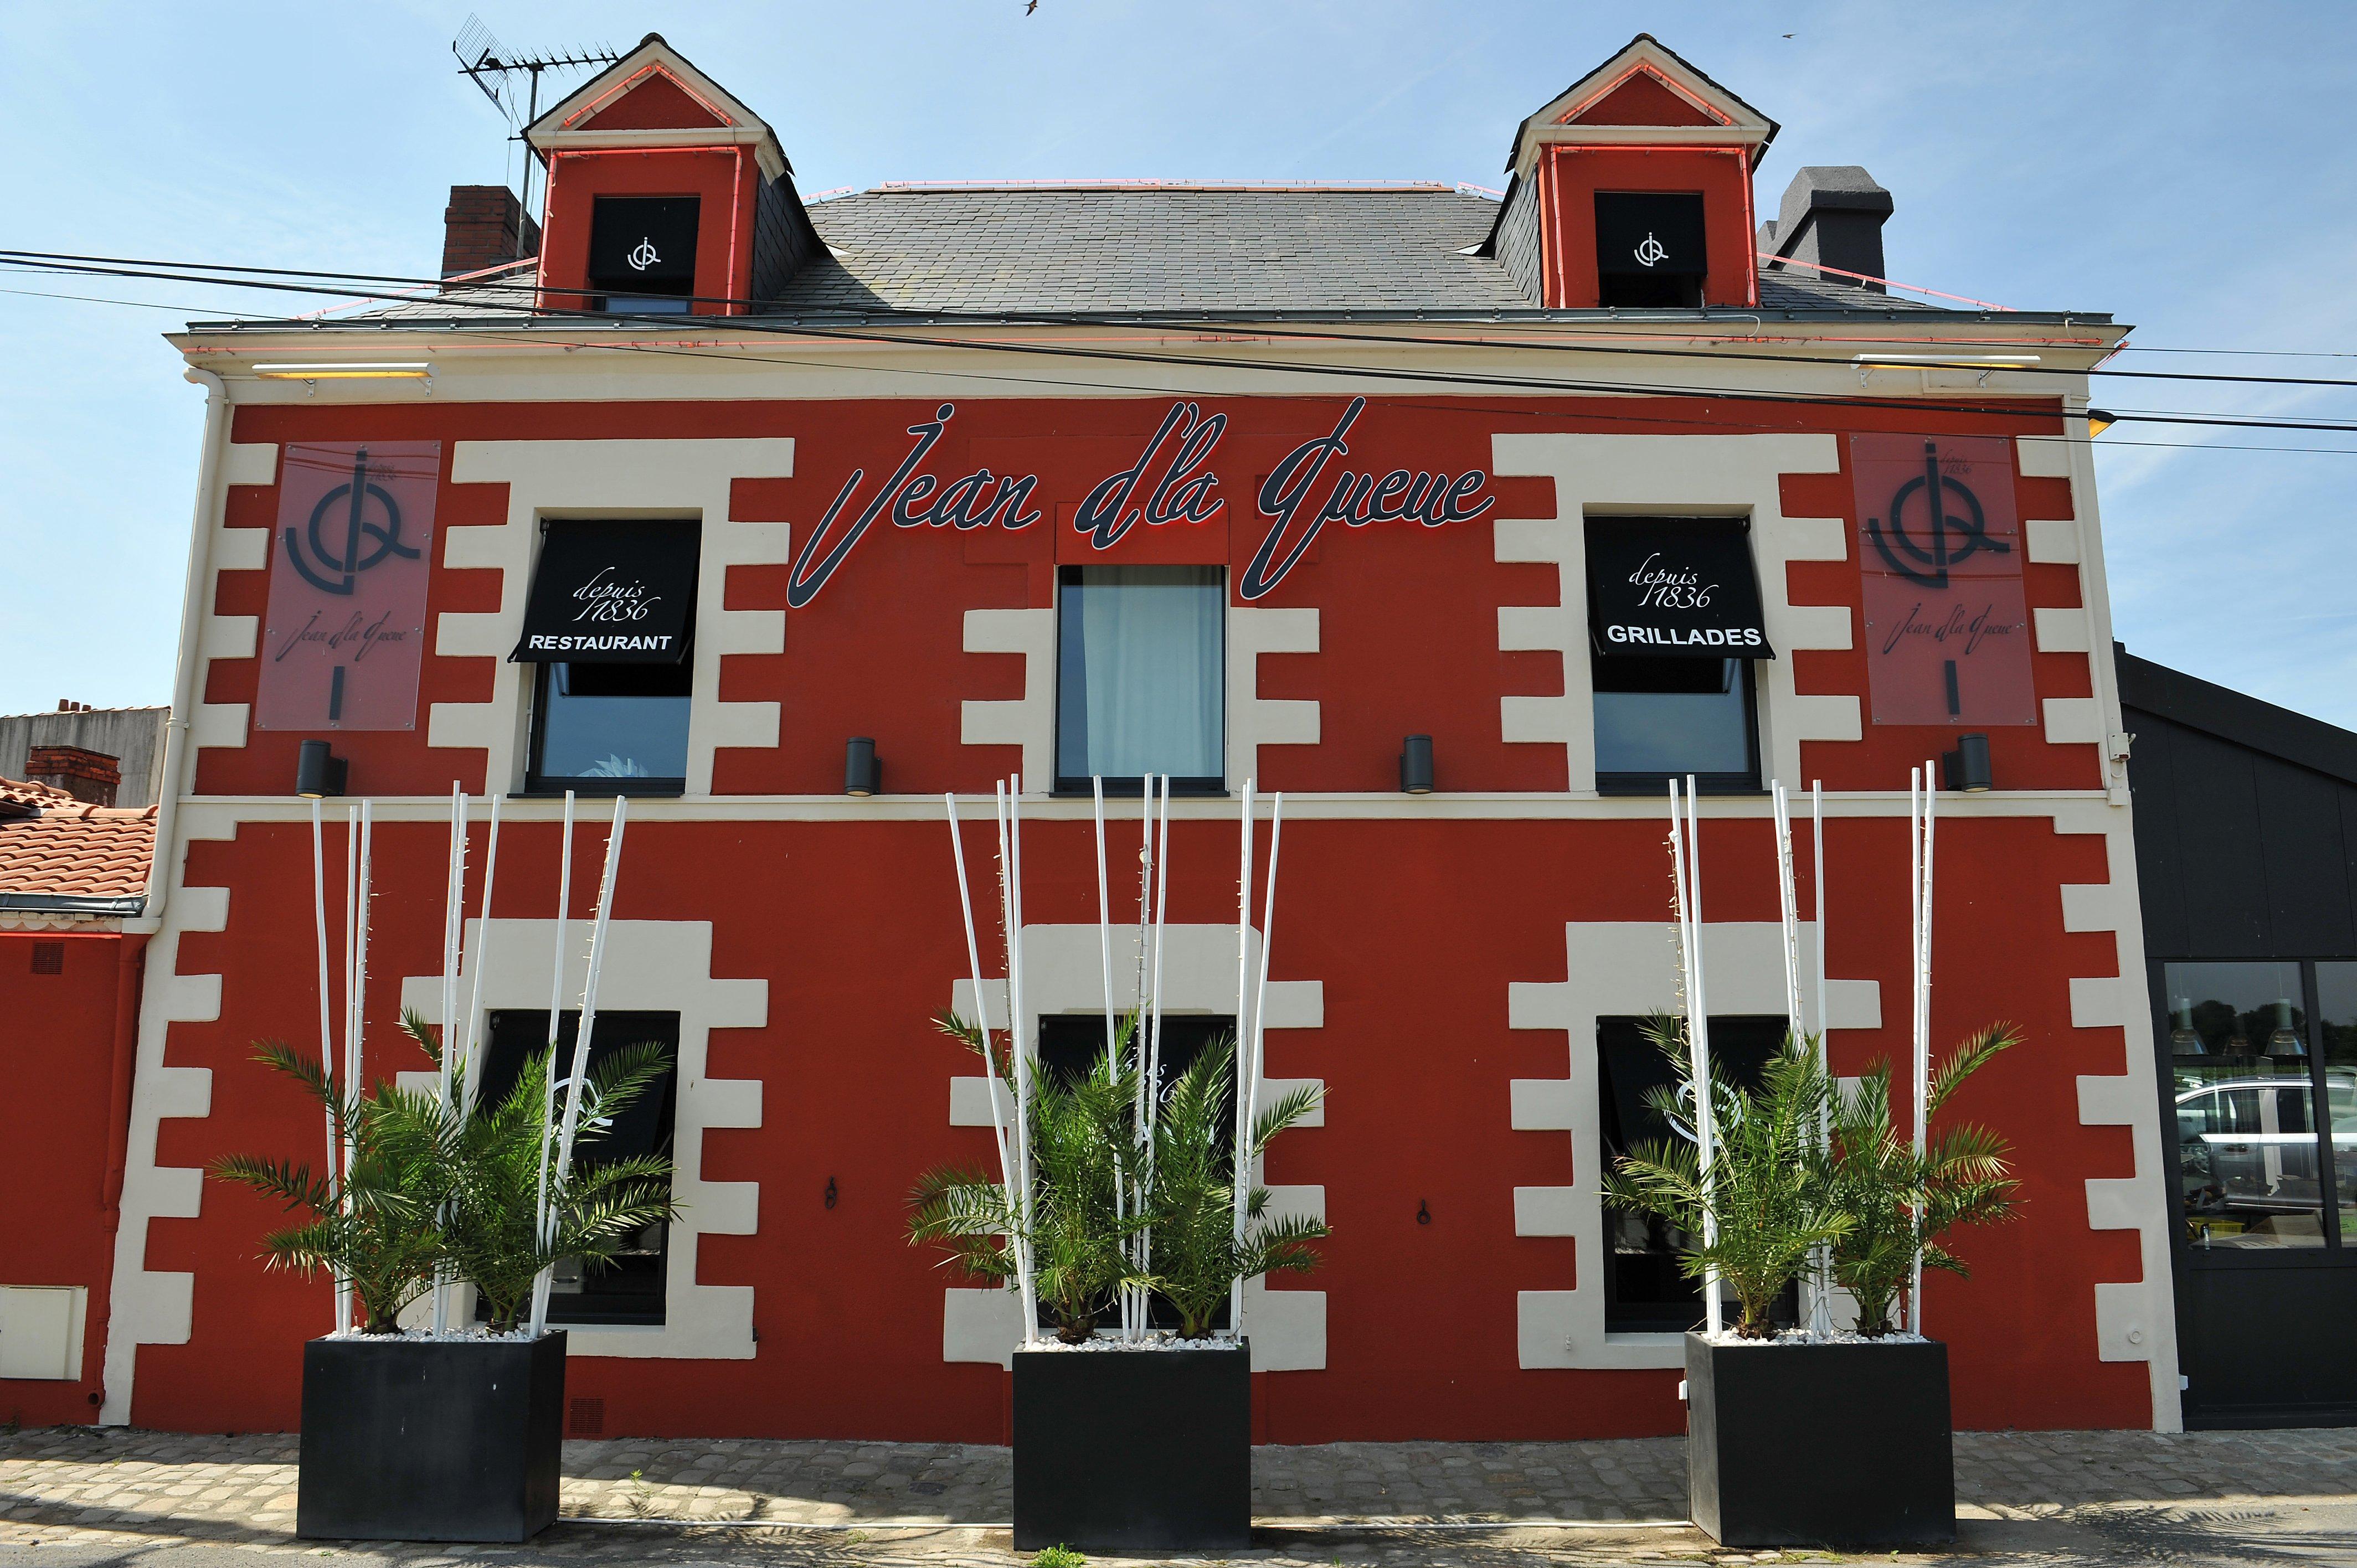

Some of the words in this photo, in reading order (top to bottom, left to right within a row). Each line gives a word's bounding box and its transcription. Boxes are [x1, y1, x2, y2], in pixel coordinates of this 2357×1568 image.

[1073, 401, 1227, 550] d'la
[1629, 553, 1698, 606] depuis
[573, 566, 645, 621] depuis
[1654, 585, 1720, 608] 1836
[593, 596, 661, 622] 1836
[529, 635, 672, 650] RESTAURANT
[1607, 625, 1762, 646] GRILLADES
